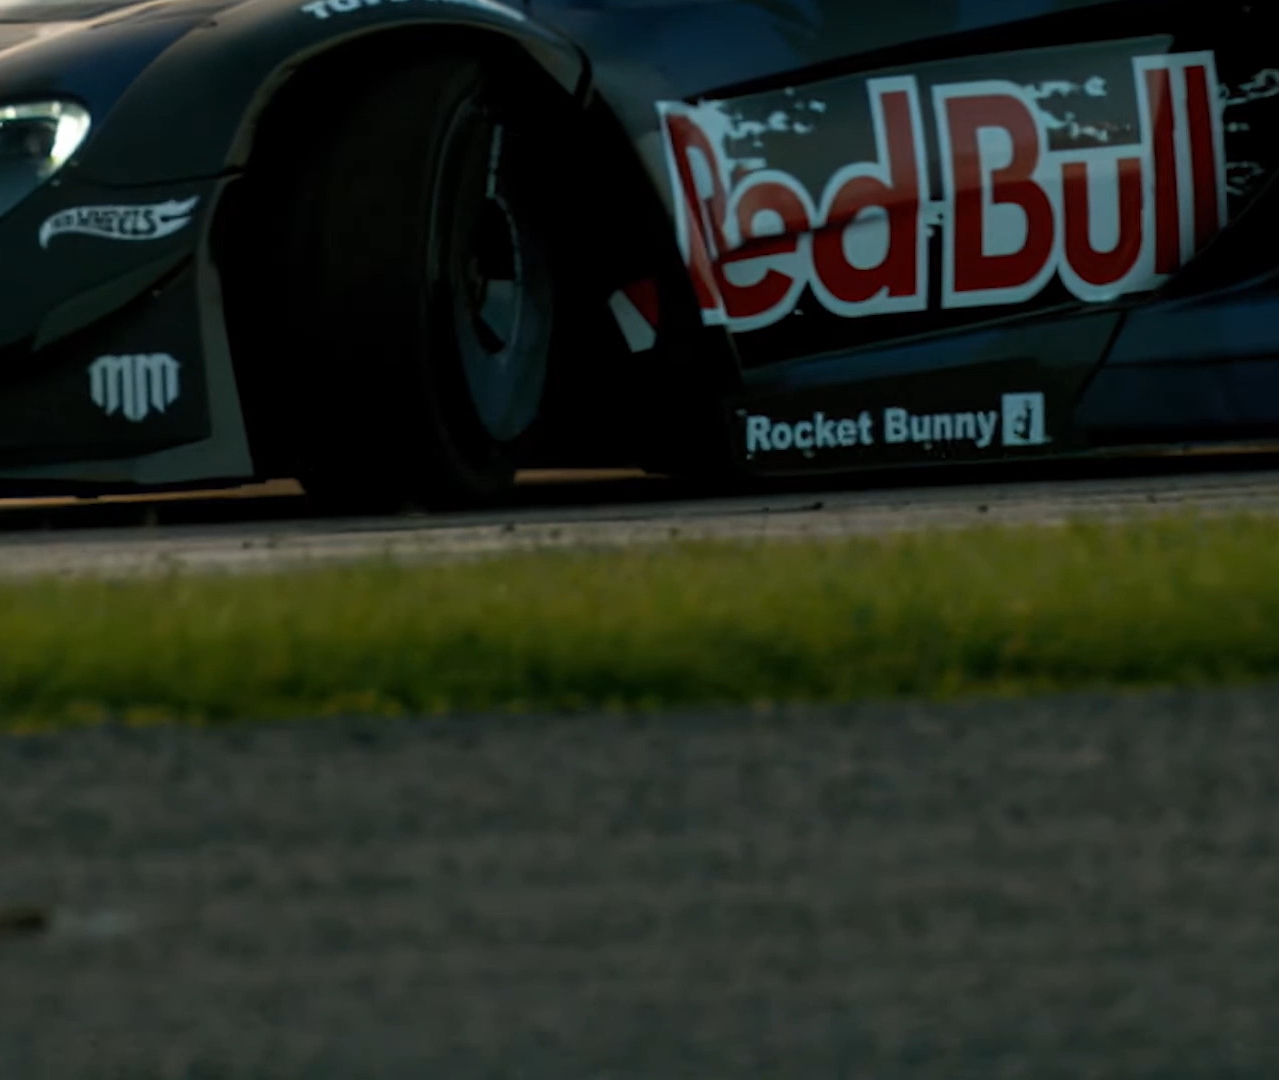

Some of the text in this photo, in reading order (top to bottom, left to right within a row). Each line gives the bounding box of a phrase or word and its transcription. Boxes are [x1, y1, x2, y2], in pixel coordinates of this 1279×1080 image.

[656, 50, 1228, 333] Red Bull
[745, 405, 999, 452] Rocket Bunny
